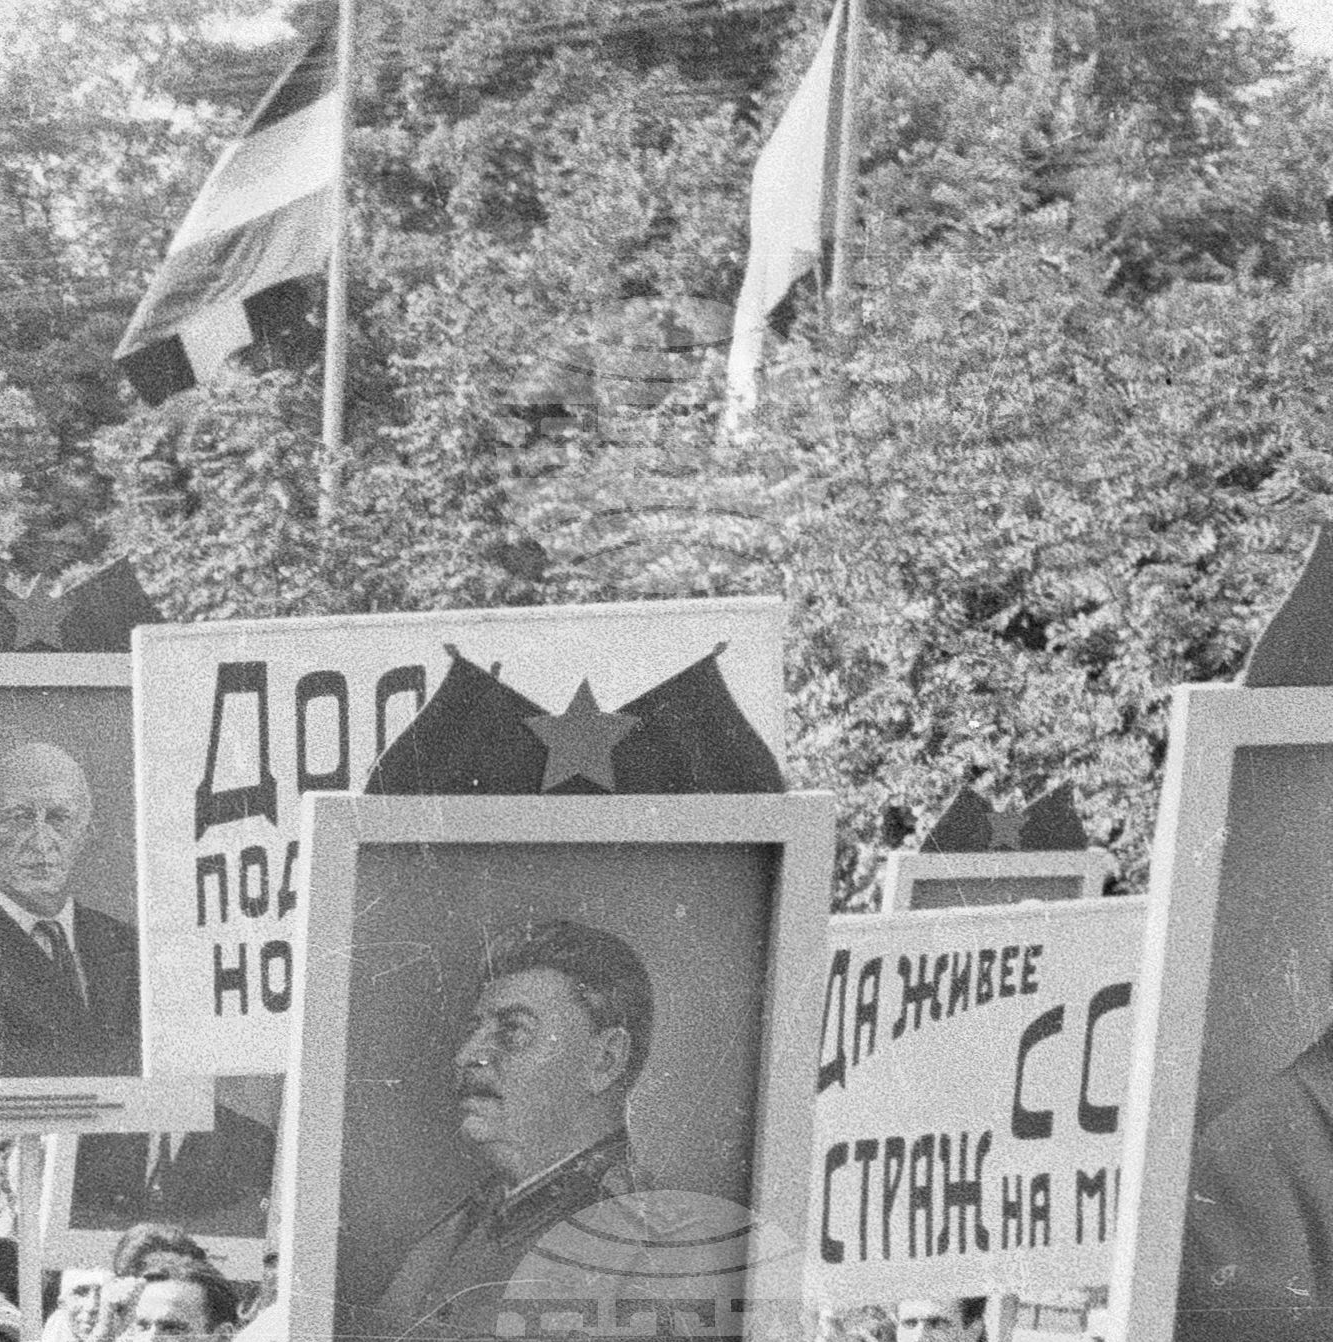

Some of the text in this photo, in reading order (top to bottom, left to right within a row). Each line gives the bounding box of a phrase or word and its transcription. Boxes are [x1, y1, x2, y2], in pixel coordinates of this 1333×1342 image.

[816, 944, 1044, 1093] ДА ЖИВЕЕ
[820, 1130, 993, 1264] СТРАЖ
[1075, 1166, 1120, 1245] М
